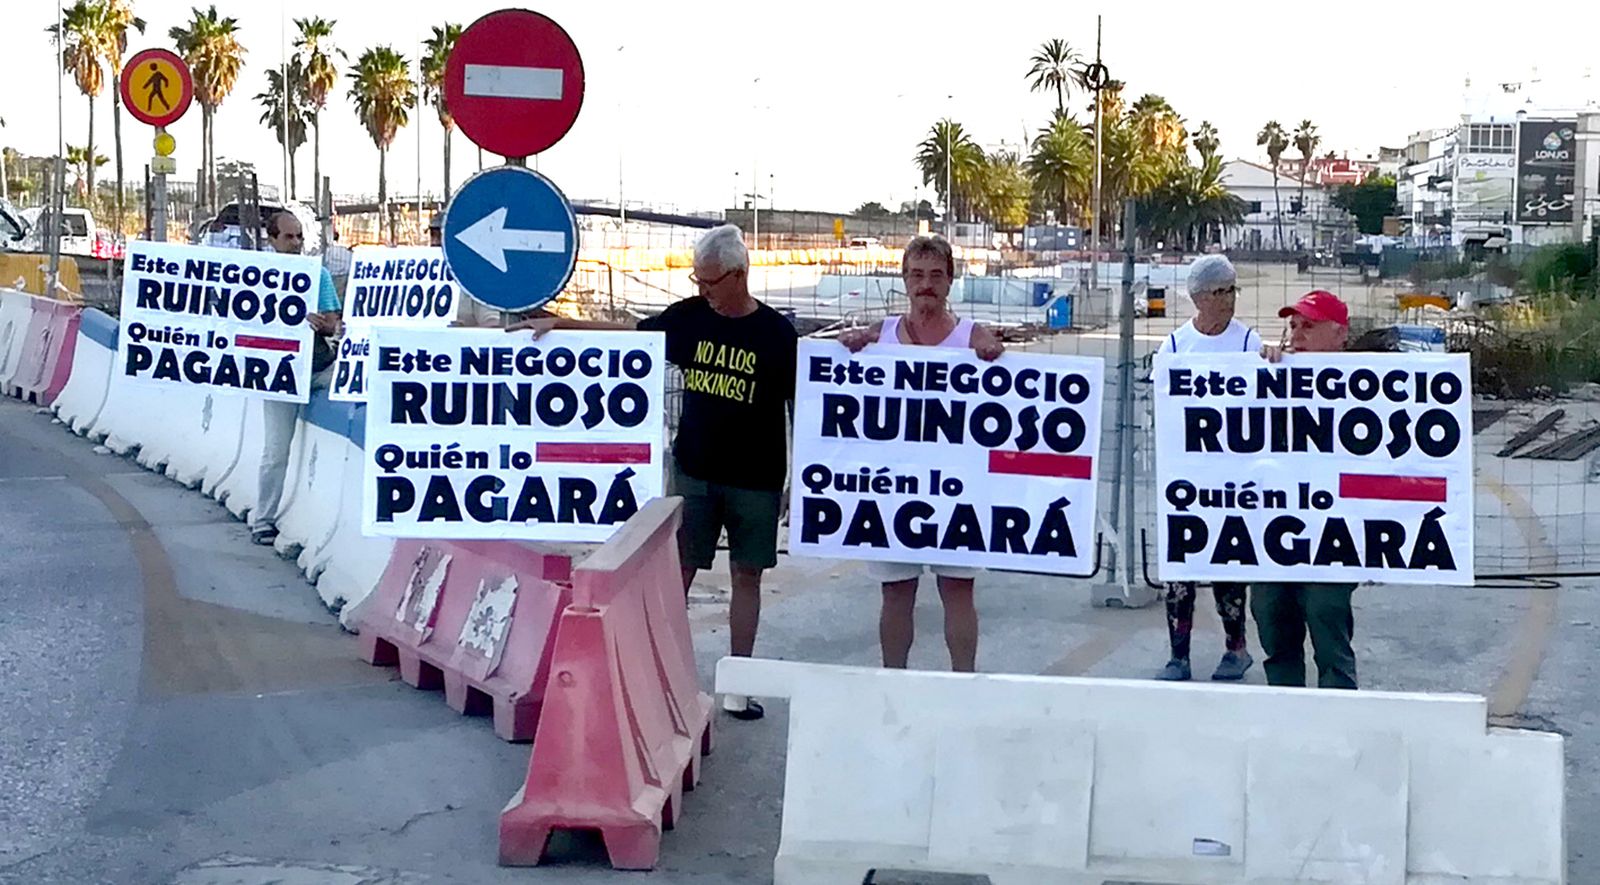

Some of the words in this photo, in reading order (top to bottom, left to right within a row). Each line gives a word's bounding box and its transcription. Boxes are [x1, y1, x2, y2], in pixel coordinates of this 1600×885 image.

[131, 254, 180, 275] Este
[184, 259, 312, 293] NEGOCIO
[353, 261, 380, 279] Este
[136, 278, 307, 326] RUINOSO
[352, 284, 453, 318] RUINOSO
[127, 322, 200, 346] Quién
[206, 330, 229, 349] lo
[341, 338, 370, 359] Quié
[125, 344, 298, 395] PAGARÁ
[378, 346, 452, 374] Este
[460, 346, 653, 379] NEGOCIO
[693, 340, 714, 364] NO
[714, 344, 726, 368] A
[729, 347, 757, 375] LOS
[808, 355, 886, 386] Este
[893, 360, 1091, 404] NEGOCIO
[1168, 368, 1248, 398] Este
[1256, 367, 1463, 405] NEGOCIO
[390, 381, 650, 430] RUINOSO
[821, 392, 1087, 454] RUINOSO
[1183, 406, 1461, 459] RUINOSO
[374, 441, 490, 474] Quién
[499, 445, 533, 471] lo
[376, 466, 640, 526] PAGARÁ
[801, 463, 919, 494] Quién
[929, 469, 964, 497] lo
[1165, 479, 1287, 511] Quién
[1298, 482, 1334, 510] lo
[800, 496, 1078, 558] PAGARÁ
[1166, 506, 1457, 571] PAGARÁ
